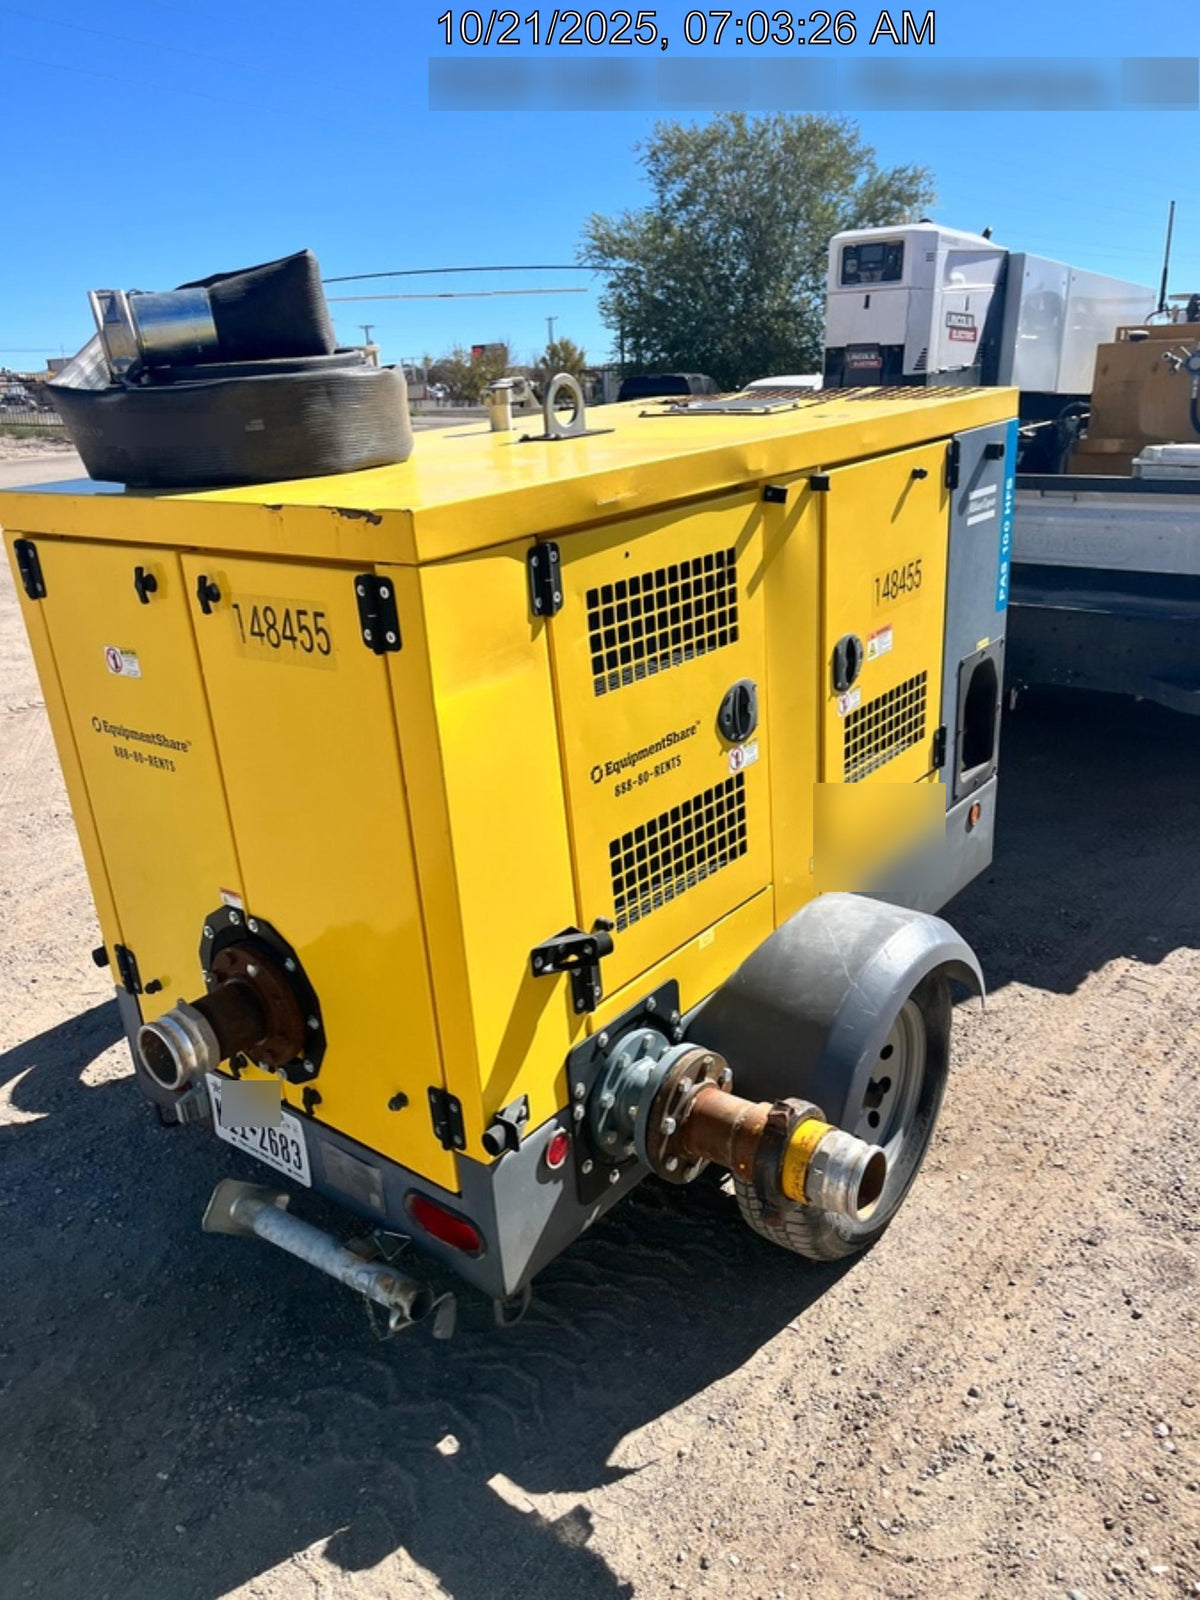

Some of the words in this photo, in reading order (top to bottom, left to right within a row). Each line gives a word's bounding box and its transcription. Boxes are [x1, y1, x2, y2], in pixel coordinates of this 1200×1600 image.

[1002, 521, 1010, 556] 100
[874, 558, 923, 608] 148455
[231, 602, 332, 657] 148455
[113, 745, 176, 773] 888-80-RENTS
[613, 754, 682, 798] 888-80-RENTS
